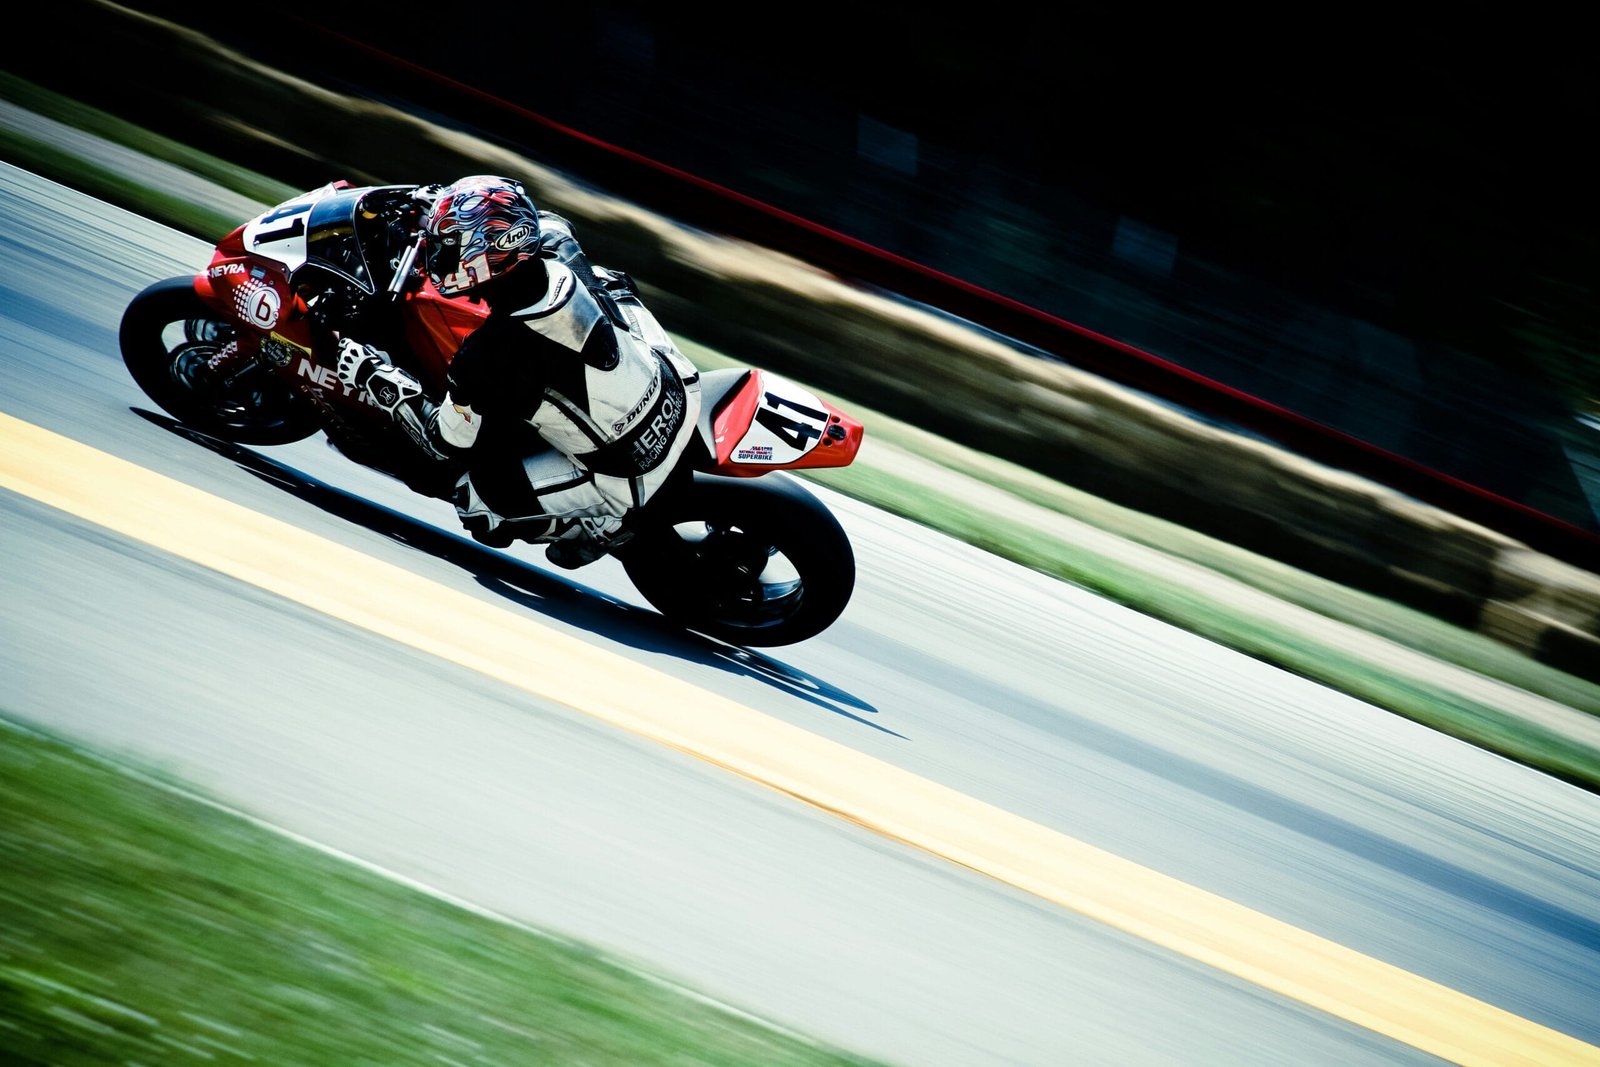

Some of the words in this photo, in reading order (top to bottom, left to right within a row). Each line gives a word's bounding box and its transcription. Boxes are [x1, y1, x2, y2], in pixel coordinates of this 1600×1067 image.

[502, 225, 528, 247] Arai
[211, 263, 245, 278] NEYRA
[444, 253, 492, 290] 41
[627, 376, 659, 424] DUNLO
[755, 391, 829, 451] 41
[639, 435, 667, 470] RACING
